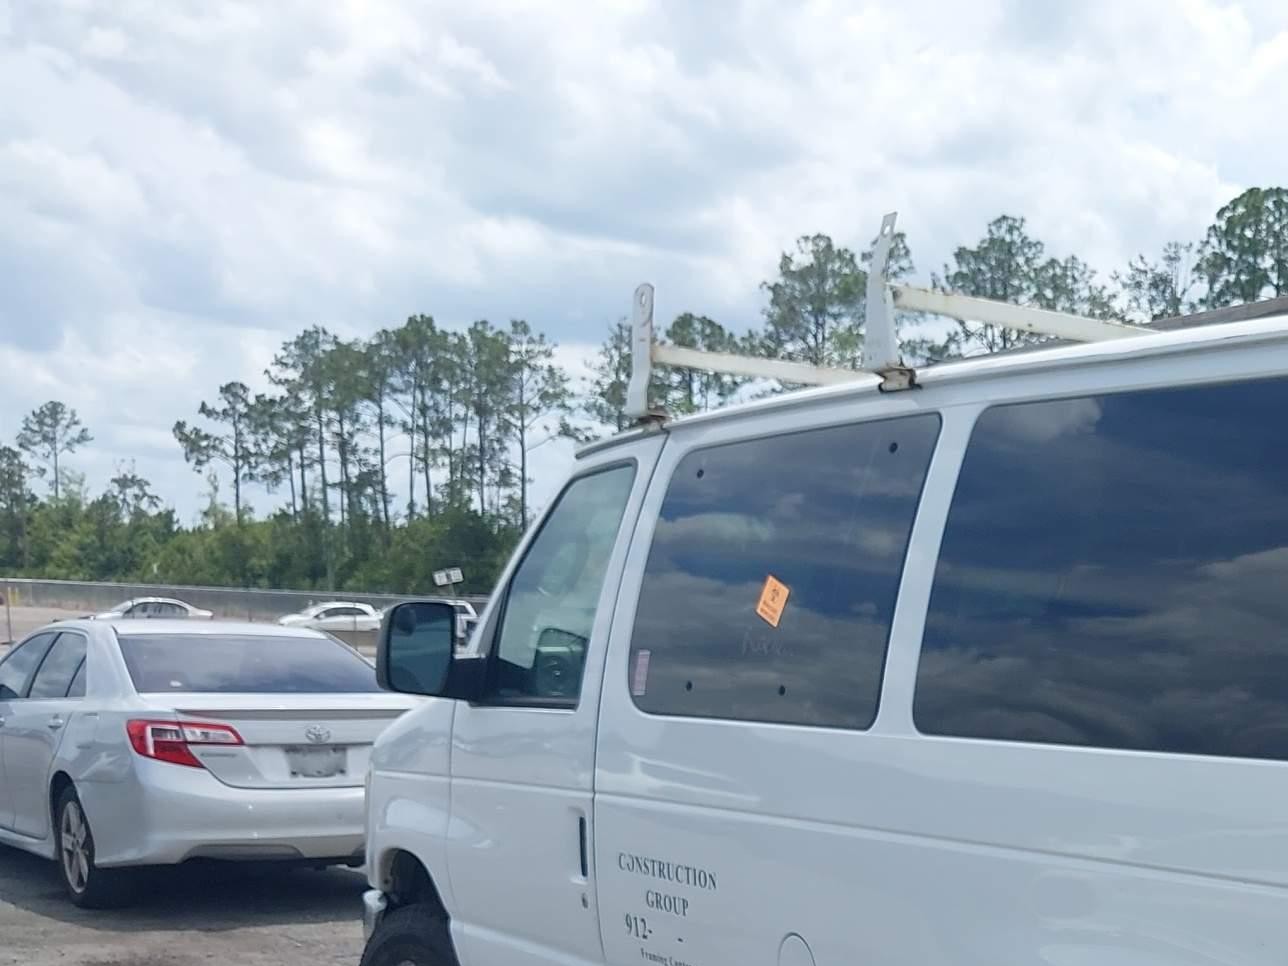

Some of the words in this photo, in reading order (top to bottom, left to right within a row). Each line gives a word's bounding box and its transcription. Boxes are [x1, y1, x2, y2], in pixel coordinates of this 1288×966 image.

[618, 853, 717, 890] CONSTRUCTION
[646, 890, 689, 917] GROUP
[640, 947, 668, 966] Framing
